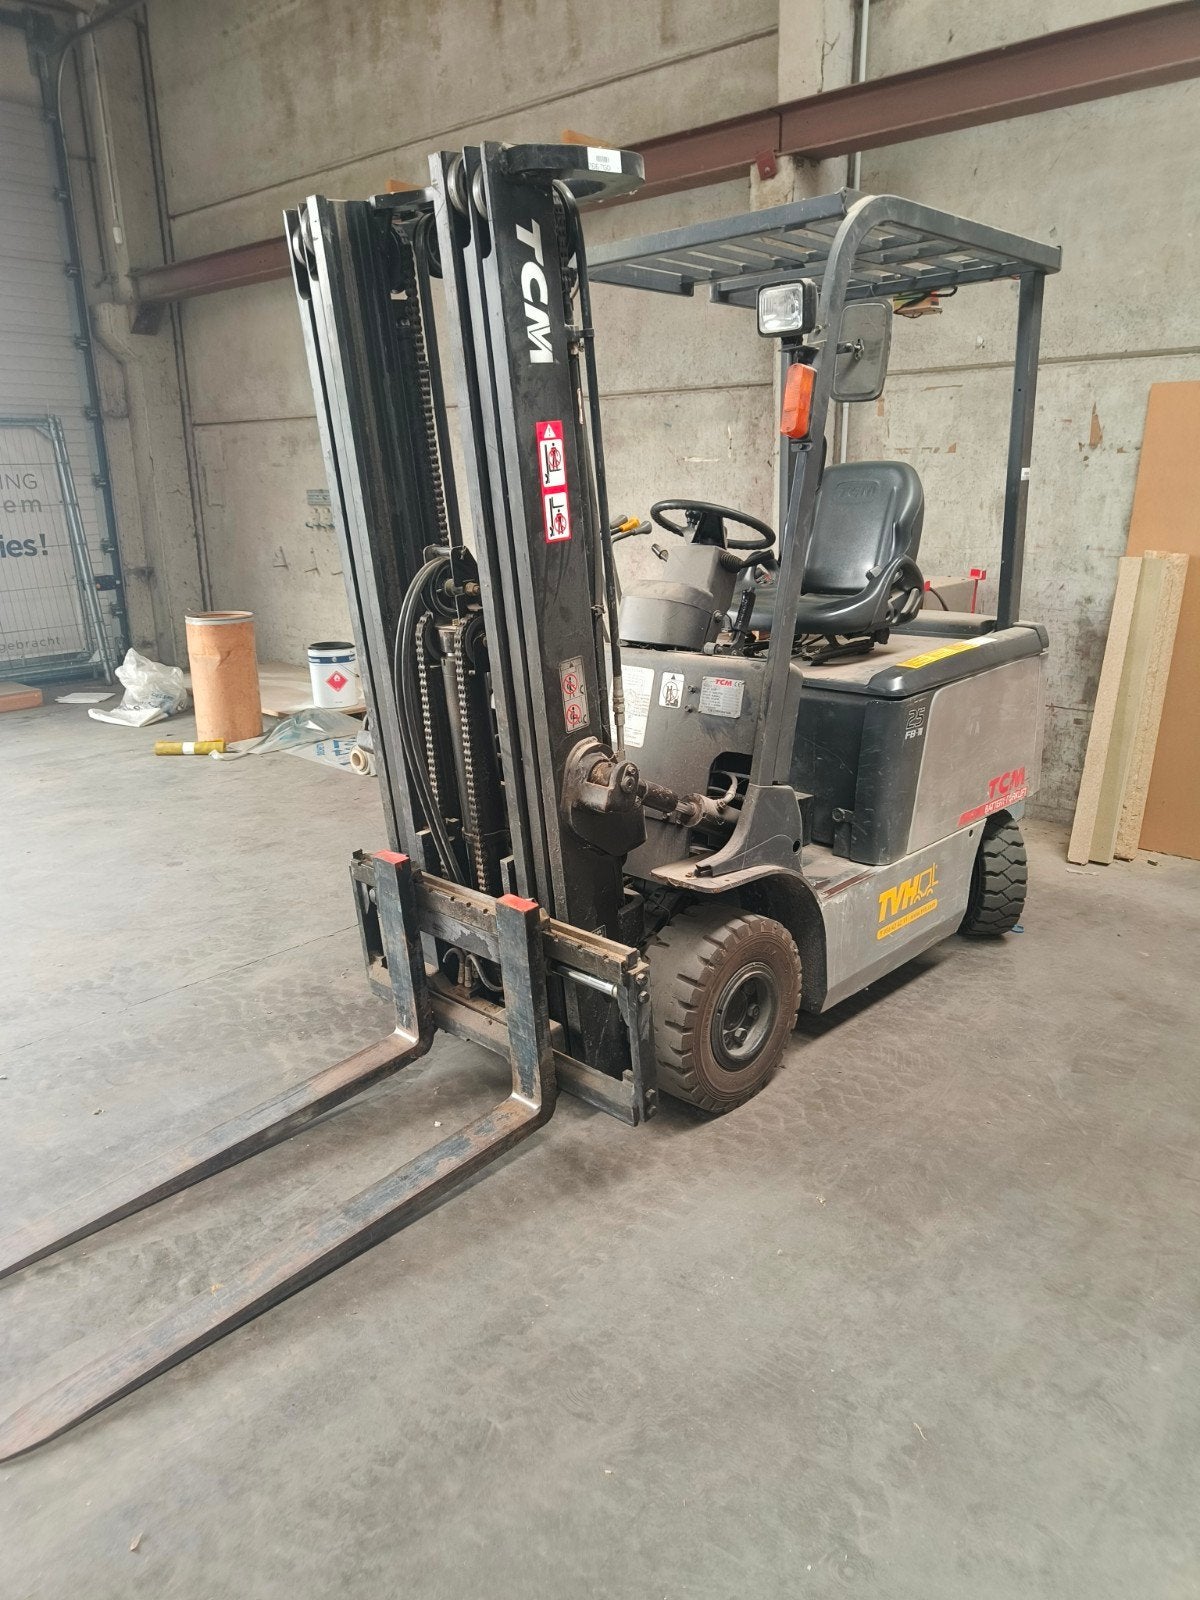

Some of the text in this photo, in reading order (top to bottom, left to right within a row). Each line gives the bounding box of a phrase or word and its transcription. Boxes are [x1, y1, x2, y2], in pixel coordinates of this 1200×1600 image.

[516, 219, 553, 363] TCM
[714, 679, 733, 687] TCM
[906, 706, 926, 731] 25
[989, 767, 1025, 799] TCM
[878, 874, 920, 923] TVH
